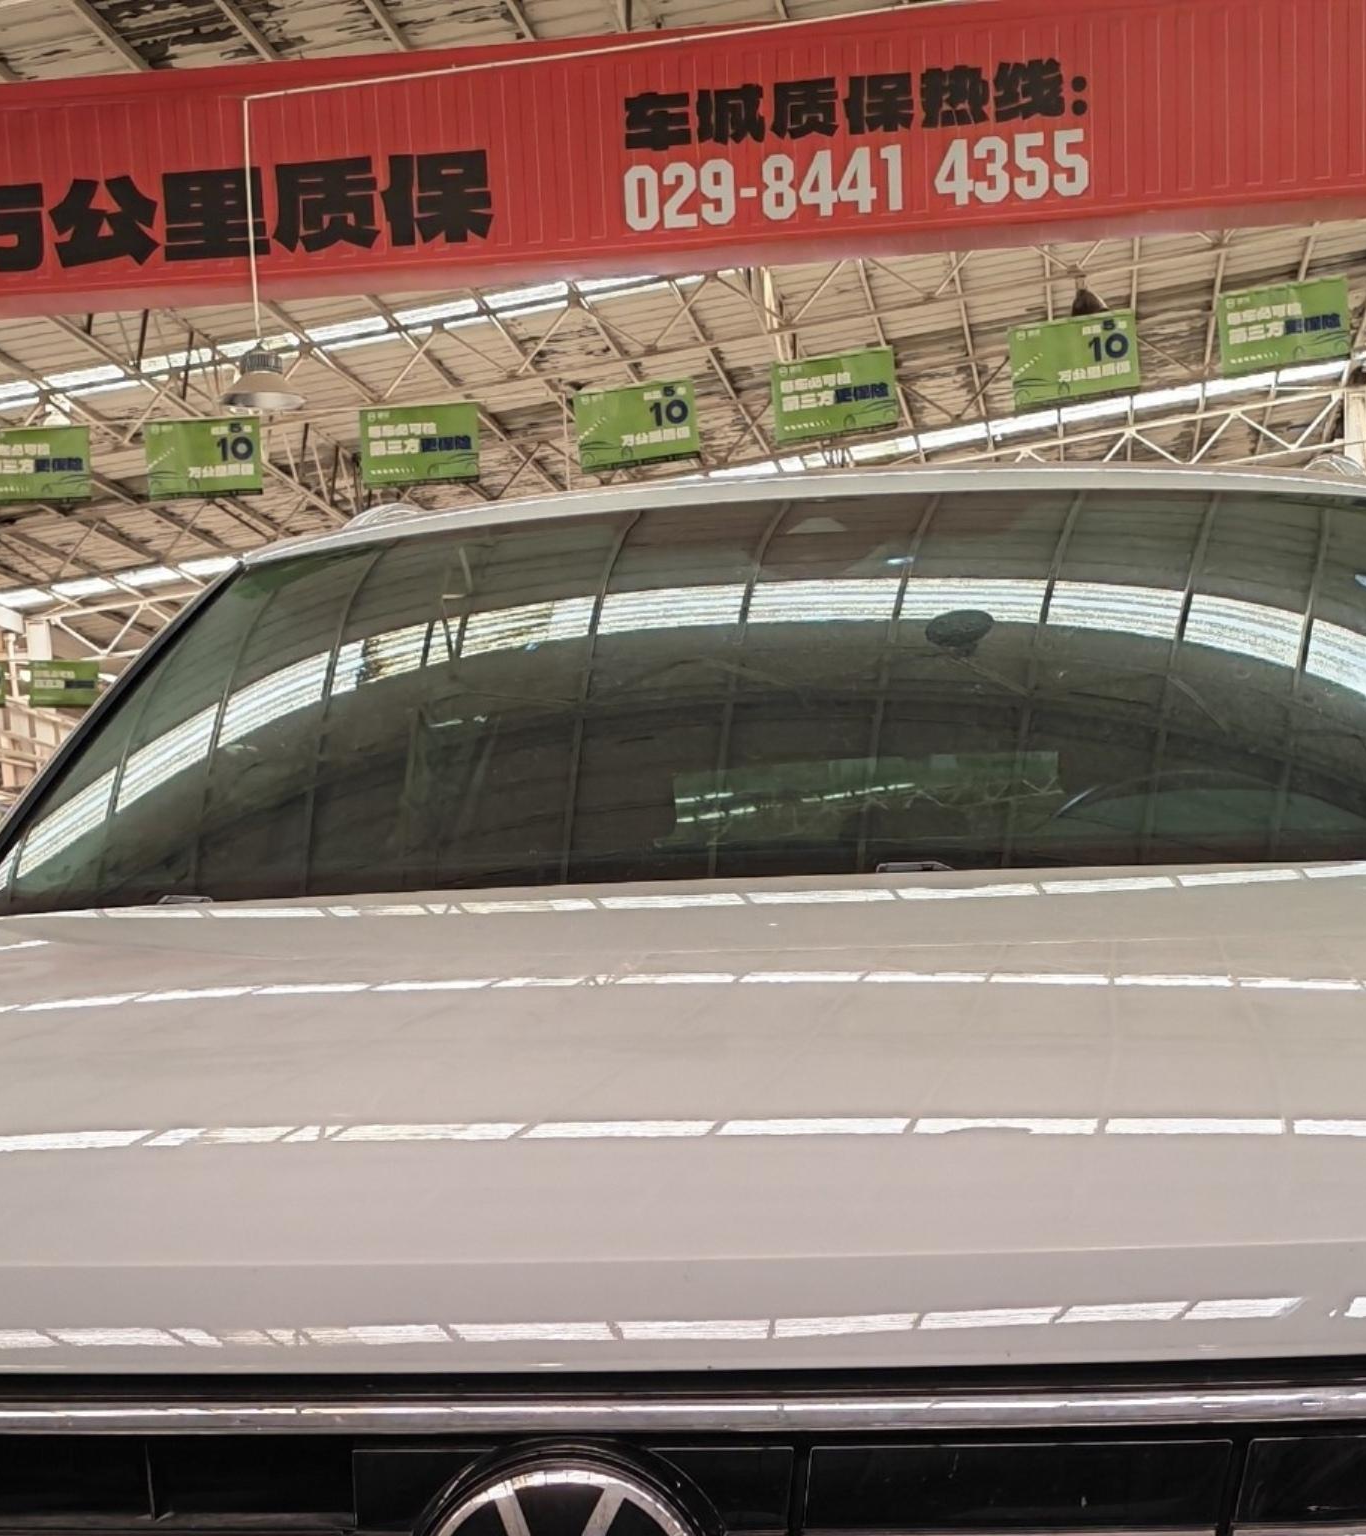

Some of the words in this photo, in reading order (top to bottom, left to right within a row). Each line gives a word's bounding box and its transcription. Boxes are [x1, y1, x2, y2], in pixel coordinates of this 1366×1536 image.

[624, 144, 903, 231] 029-8441
[935, 128, 1089, 206] 4355
[1088, 332, 1129, 362] 10
[649, 399, 689, 427] 10
[216, 436, 254, 462] 10
